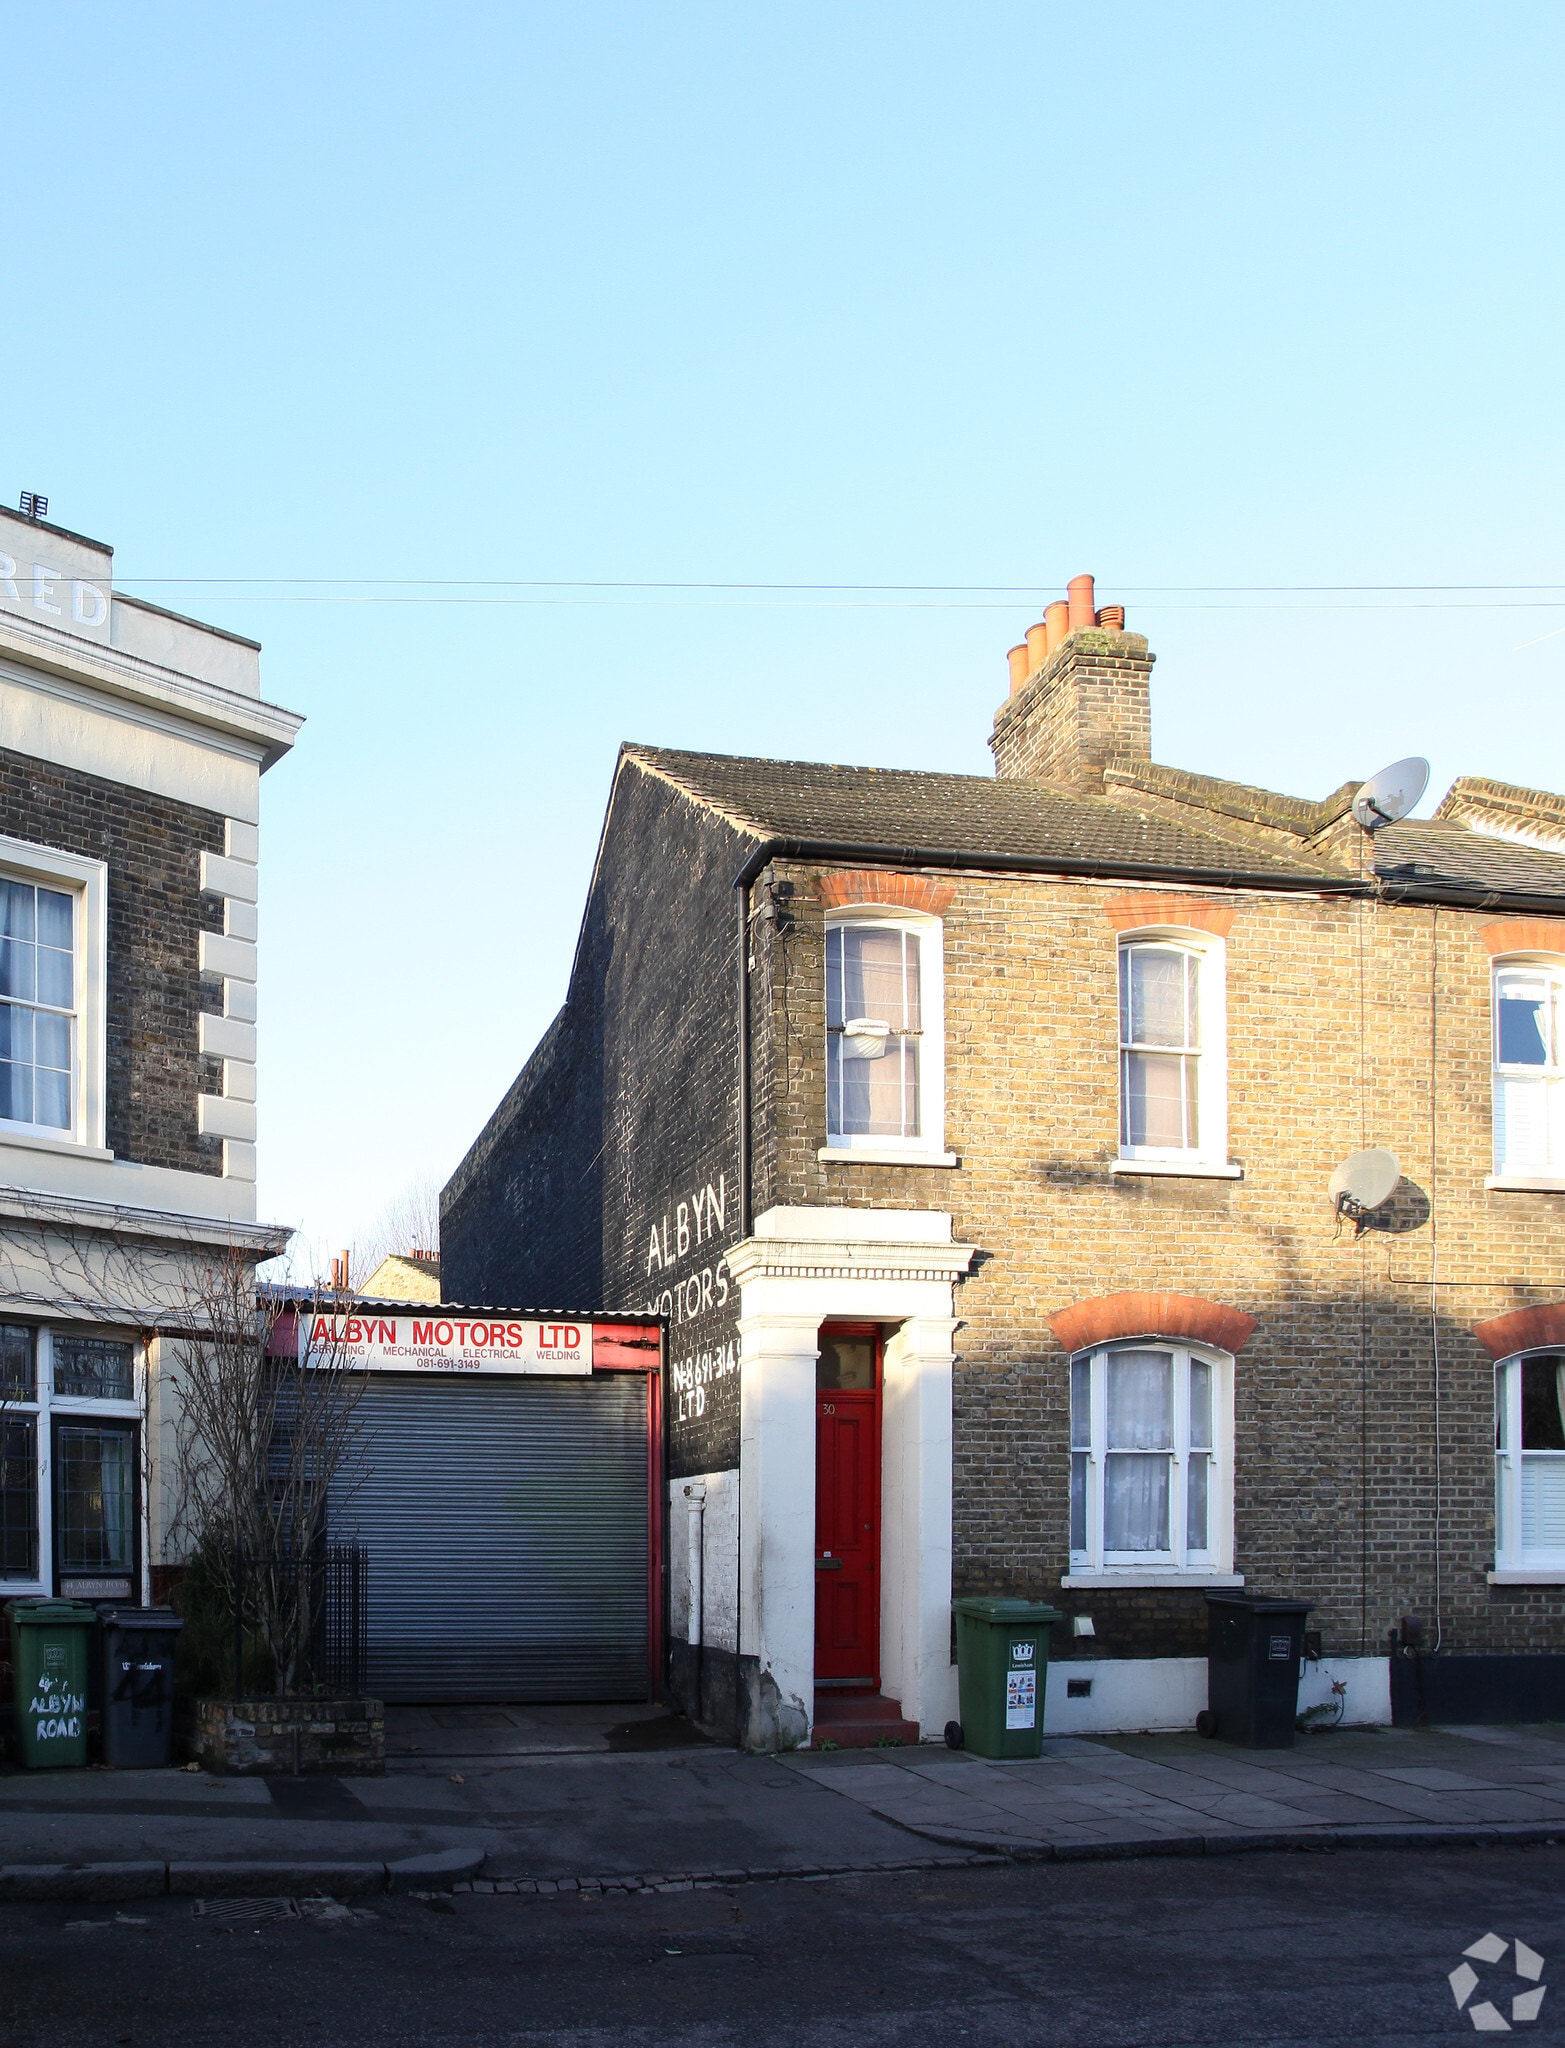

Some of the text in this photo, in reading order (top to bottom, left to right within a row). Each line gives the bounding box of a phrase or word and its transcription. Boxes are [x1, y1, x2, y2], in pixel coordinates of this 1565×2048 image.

[647, 1174, 725, 1277] ALBYN
[312, 1318, 581, 1349] ALBYN MOTORS LTD
[312, 1344, 581, 1361] SERVICING MECHANICAL ELECTRICAL WELDING
[416, 1358, 481, 1370] 081-691-3149
[678, 1386, 705, 1421] LTD
[823, 1403, 836, 1415] 30
[76, 1581, 103, 1589] ALBYN
[105, 1580, 129, 1589] ROAD
[28, 1691, 85, 1714] ALBYN
[36, 1716, 81, 1742] ROAD
